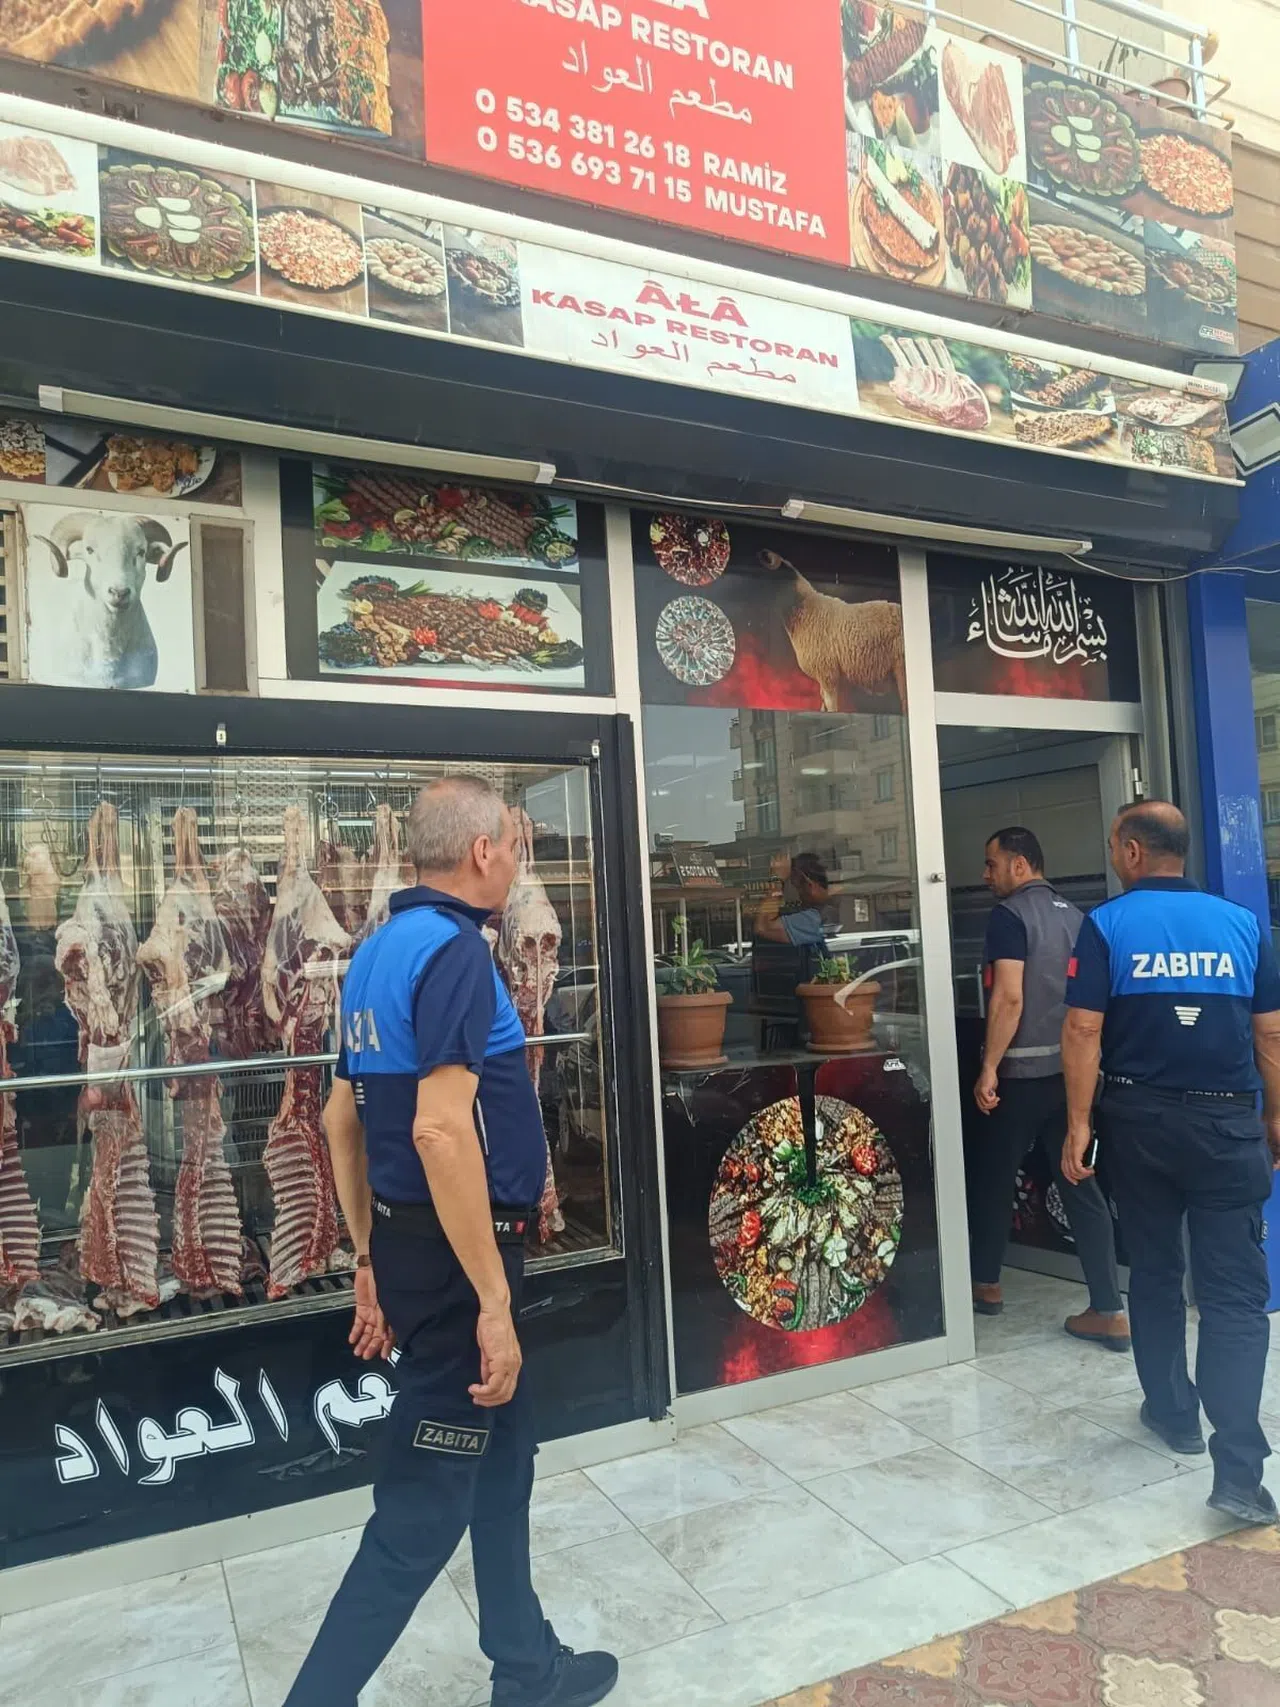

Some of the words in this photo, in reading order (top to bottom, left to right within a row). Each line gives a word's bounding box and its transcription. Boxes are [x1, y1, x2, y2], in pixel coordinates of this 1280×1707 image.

[631, 13, 794, 90] RESTORAN
[669, 76, 753, 125] مطعم
[506, 95, 561, 133] 534
[569, 114, 616, 149] 381
[623, 129, 656, 159] 26
[663, 139, 691, 169] 18
[703, 151, 788, 196] RAMİZ
[507, 132, 562, 170] 536
[571, 152, 622, 185] 693
[629, 165, 656, 195] 71
[664, 175, 692, 203] 15
[704, 185, 828, 239] MUSTAFA
[531, 288, 656, 326] KASAP
[666, 318, 839, 369] RESTORAN
[706, 356, 797, 384] مطعم
[1131, 951, 1236, 979] ZABITA
[54, 1367, 289, 1484] العواد
[421, 1427, 479, 1450] ZABITA
